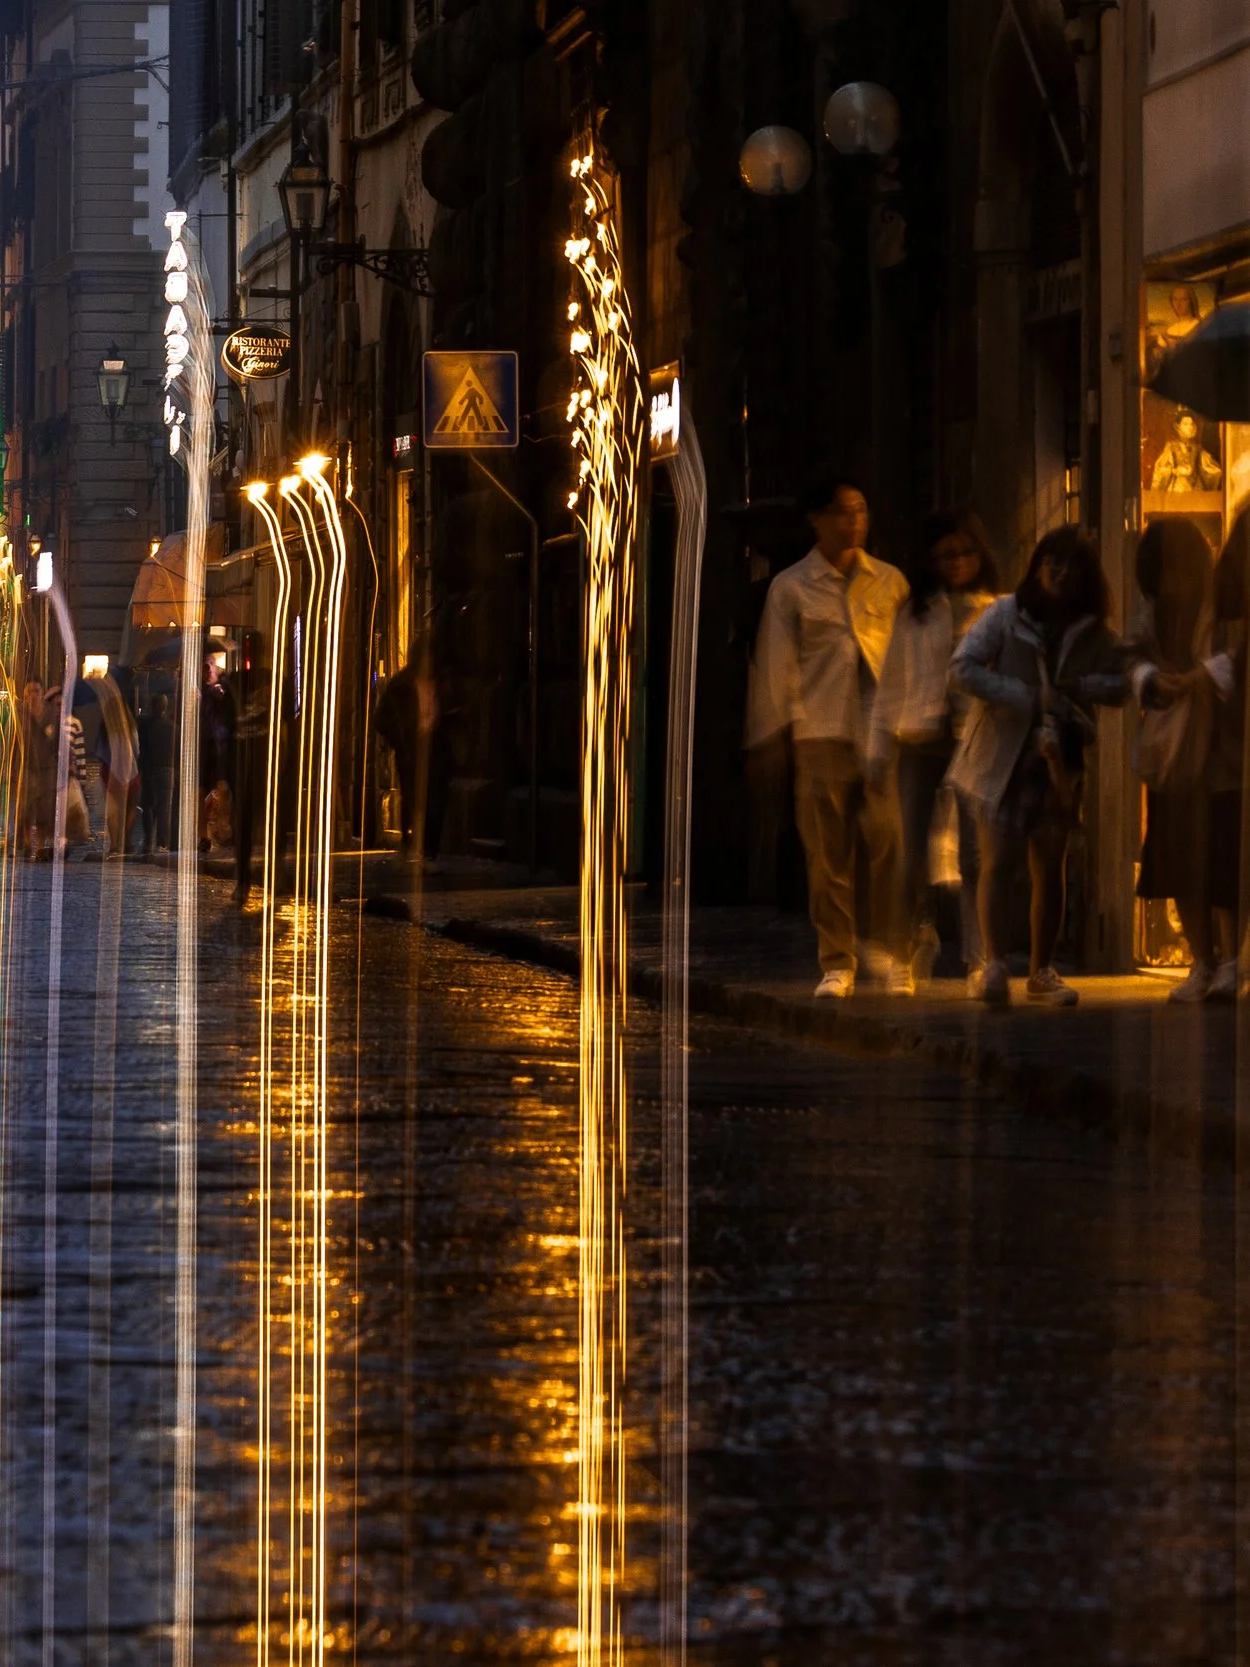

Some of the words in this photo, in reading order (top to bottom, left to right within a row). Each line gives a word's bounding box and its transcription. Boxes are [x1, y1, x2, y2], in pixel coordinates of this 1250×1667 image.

[231, 336, 291, 348] RISTORANTE
[238, 345, 283, 357] PIZZERIA
[241, 356, 280, 373] Ginori
